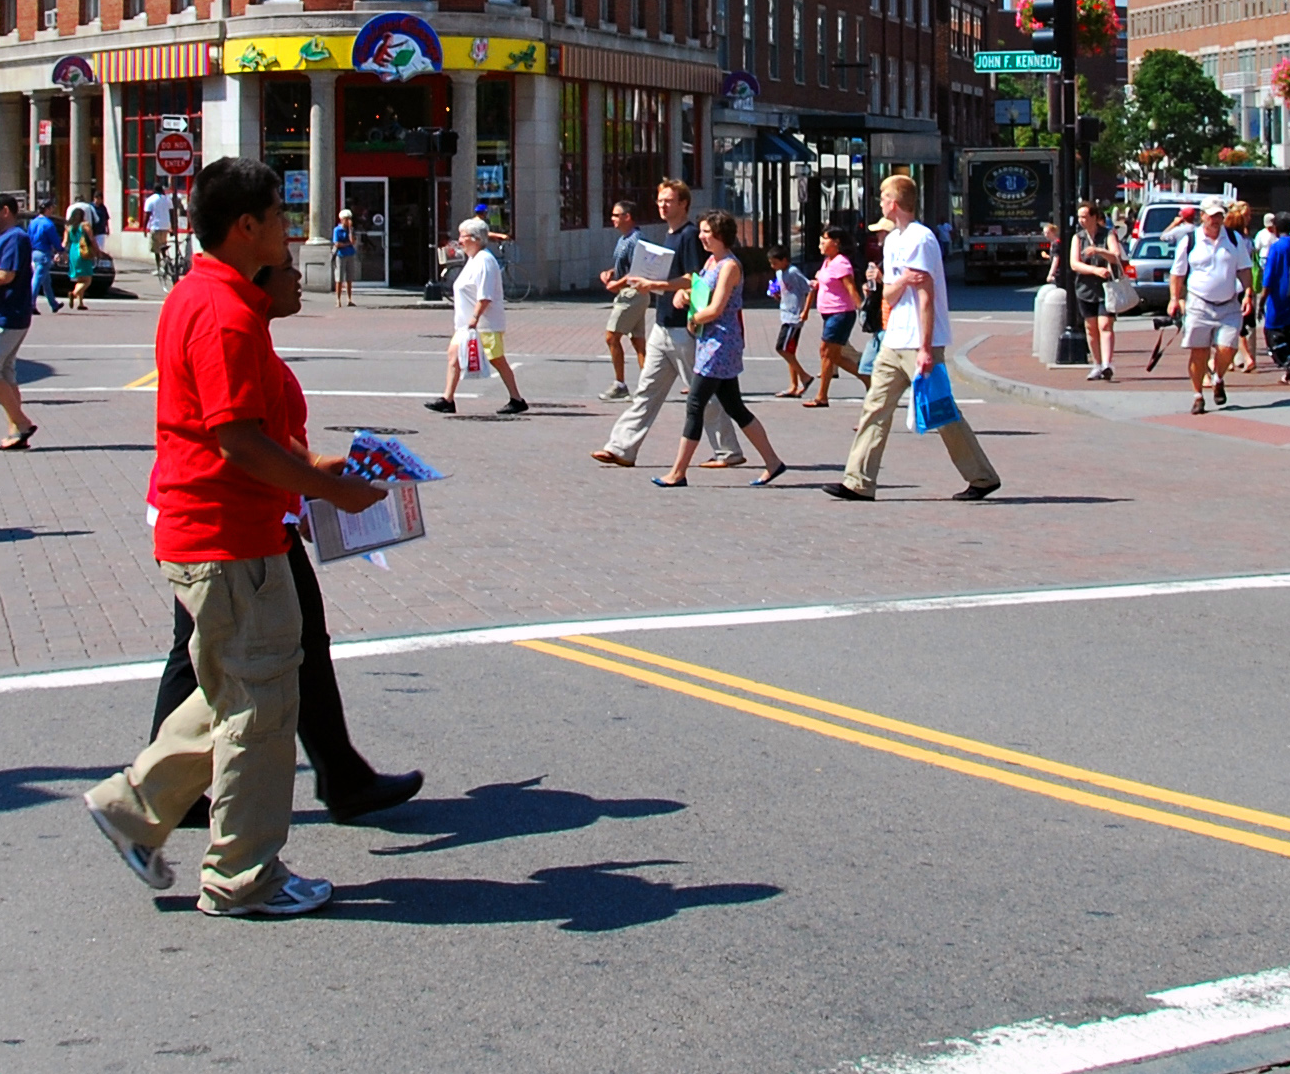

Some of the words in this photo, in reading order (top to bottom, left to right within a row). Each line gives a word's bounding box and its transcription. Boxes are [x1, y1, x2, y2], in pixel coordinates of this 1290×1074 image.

[977, 55, 1001, 69] JOHN
[1004, 55, 1012, 68] F.
[165, 160, 186, 168] ENTER
[996, 192, 1026, 200] COFFEE
